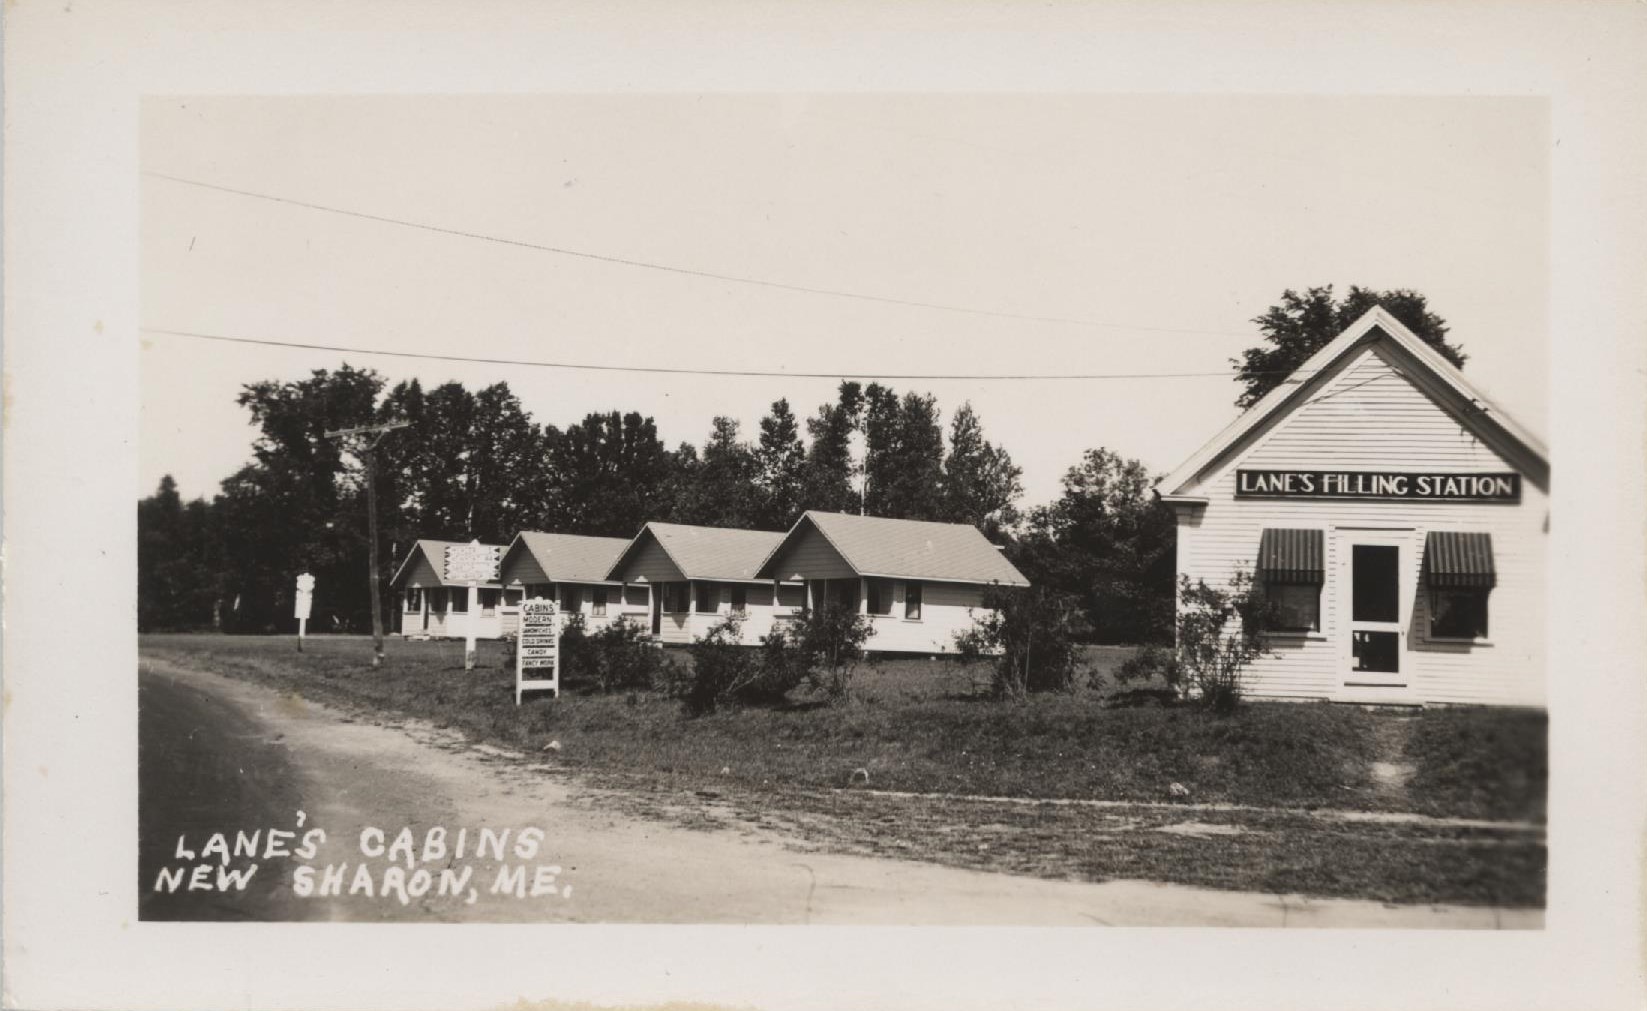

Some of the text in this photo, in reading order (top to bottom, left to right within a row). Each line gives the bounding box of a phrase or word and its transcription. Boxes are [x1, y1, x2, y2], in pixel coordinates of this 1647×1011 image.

[1241, 473, 1514, 496] LANE'S FILLING STATION
[523, 604, 554, 612] CABINS
